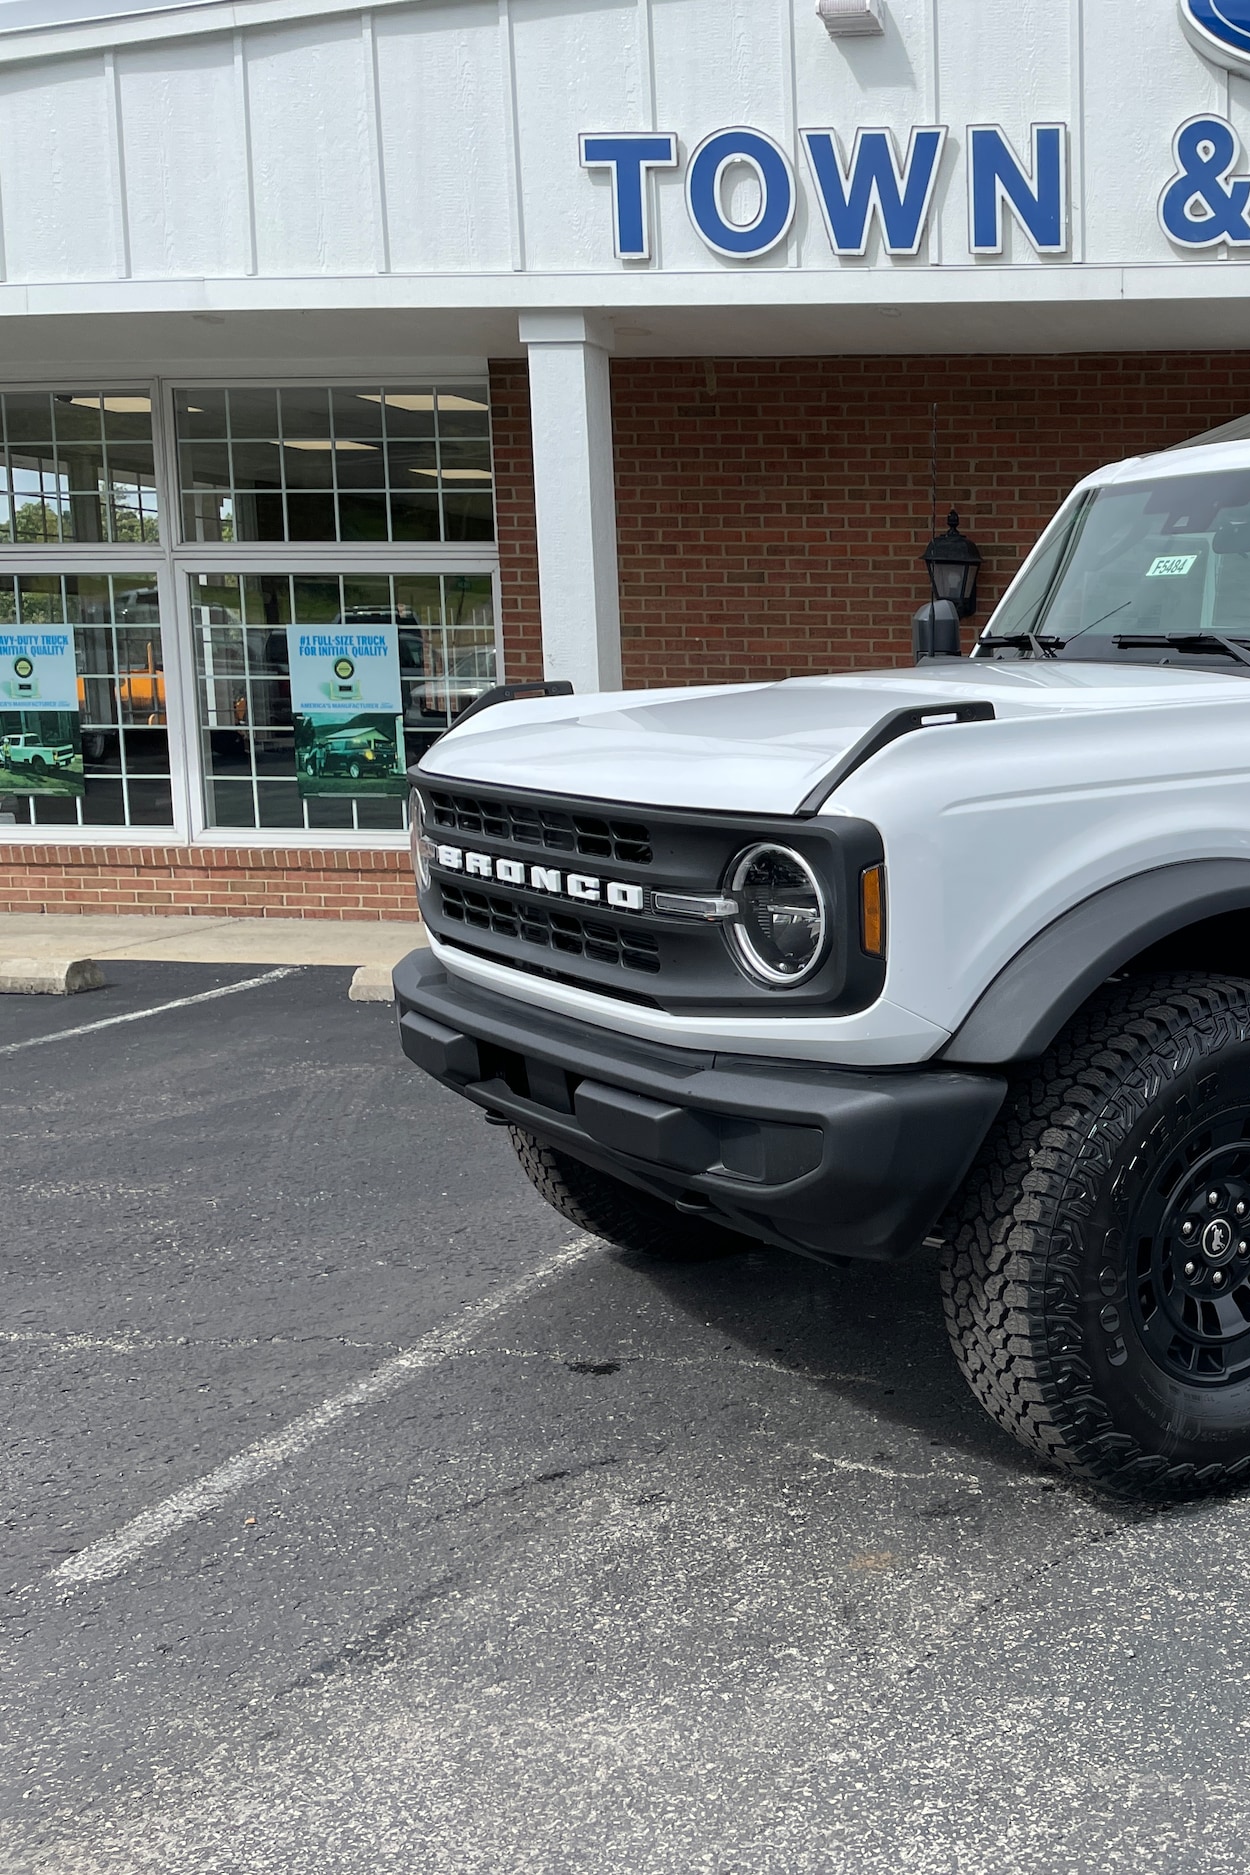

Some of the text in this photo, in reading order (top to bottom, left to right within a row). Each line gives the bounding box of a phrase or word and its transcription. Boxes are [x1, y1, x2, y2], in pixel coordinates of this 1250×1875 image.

[578, 122, 1070, 264] TOWN
[1151, 559, 1188, 575] F5484
[41, 635, 68, 645] TRUCK
[300, 636, 385, 646] #1 FULL-SIZE TRUCK
[30, 646, 65, 657] QUALITY
[299, 646, 388, 657] FOR INITIAL QUALITY
[437, 845, 644, 910] BRONCO
